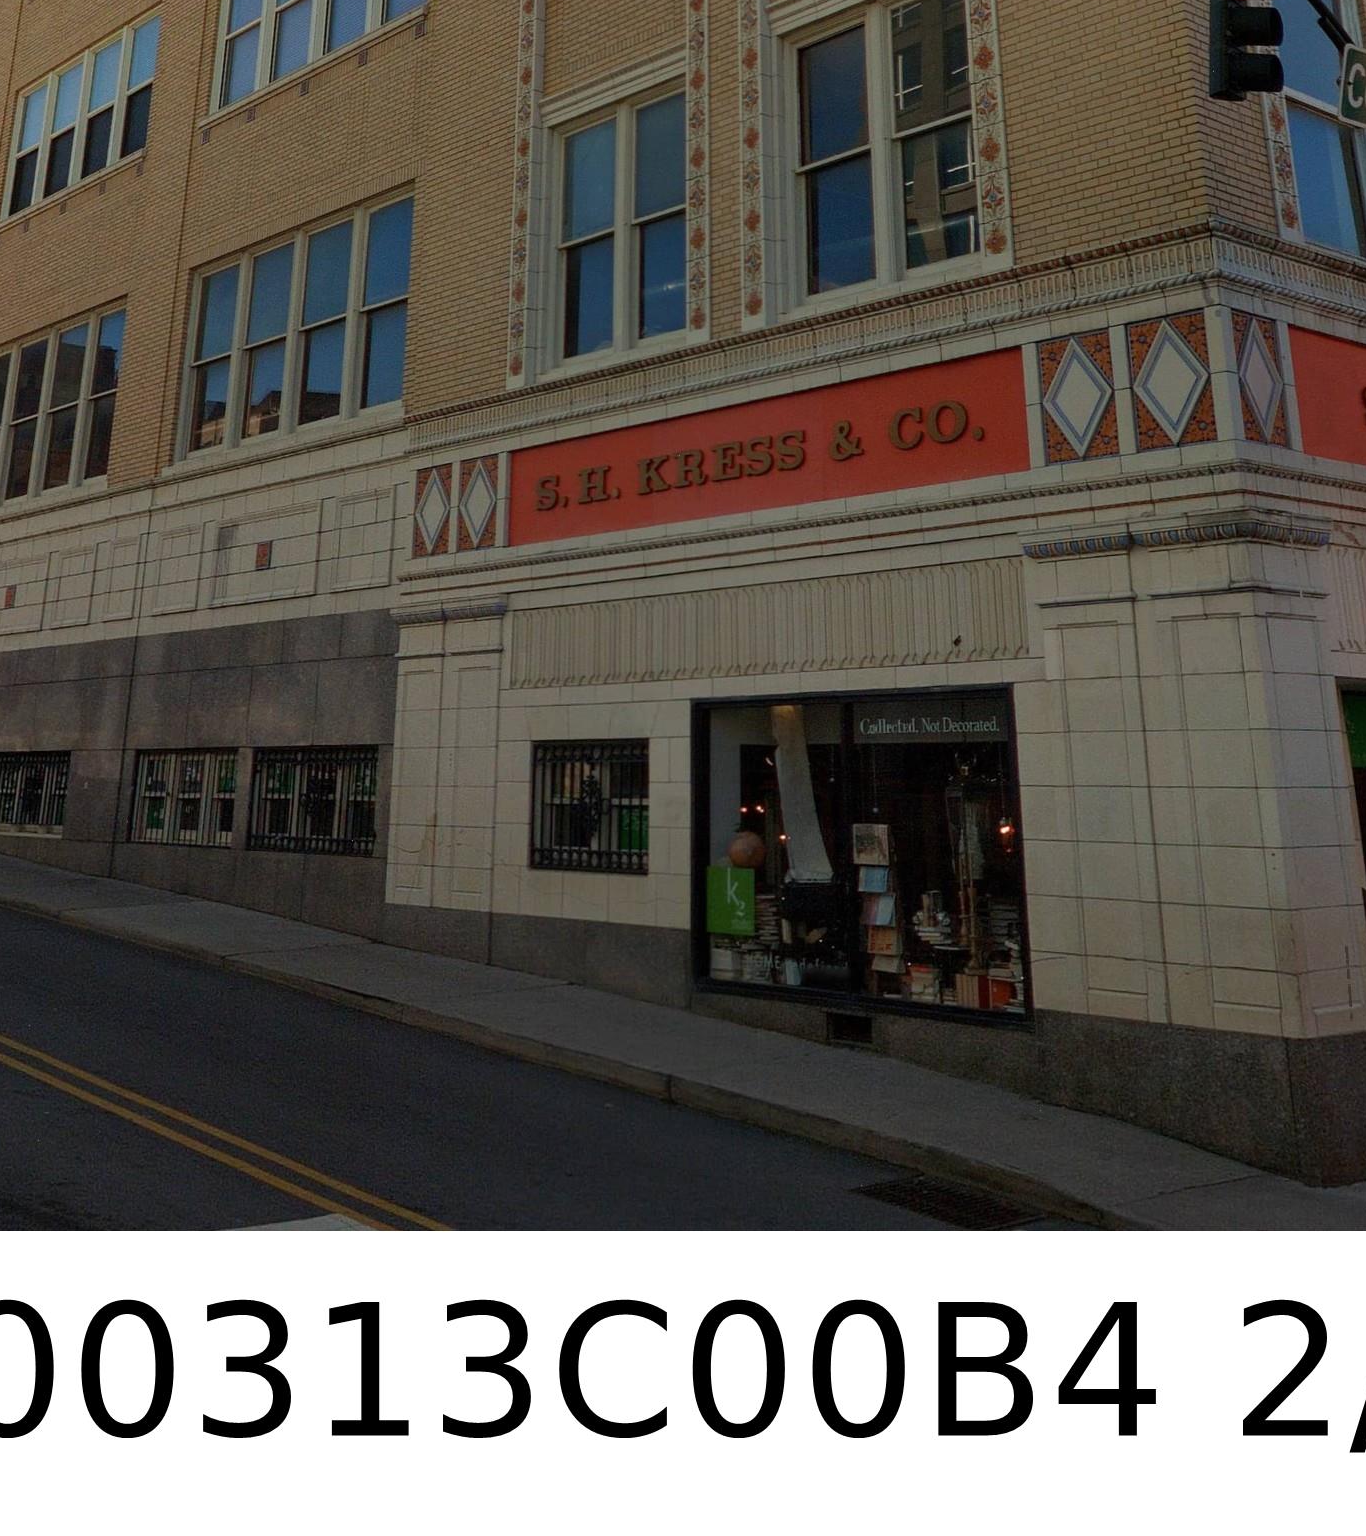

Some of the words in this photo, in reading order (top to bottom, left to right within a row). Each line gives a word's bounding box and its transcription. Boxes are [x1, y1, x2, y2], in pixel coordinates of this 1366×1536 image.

[637, 430, 807, 496] KRESS
[829, 420, 865, 462] &
[888, 399, 986, 451] CO.
[921, 717, 940, 733] Not
[942, 716, 1000, 733] Decorated.
